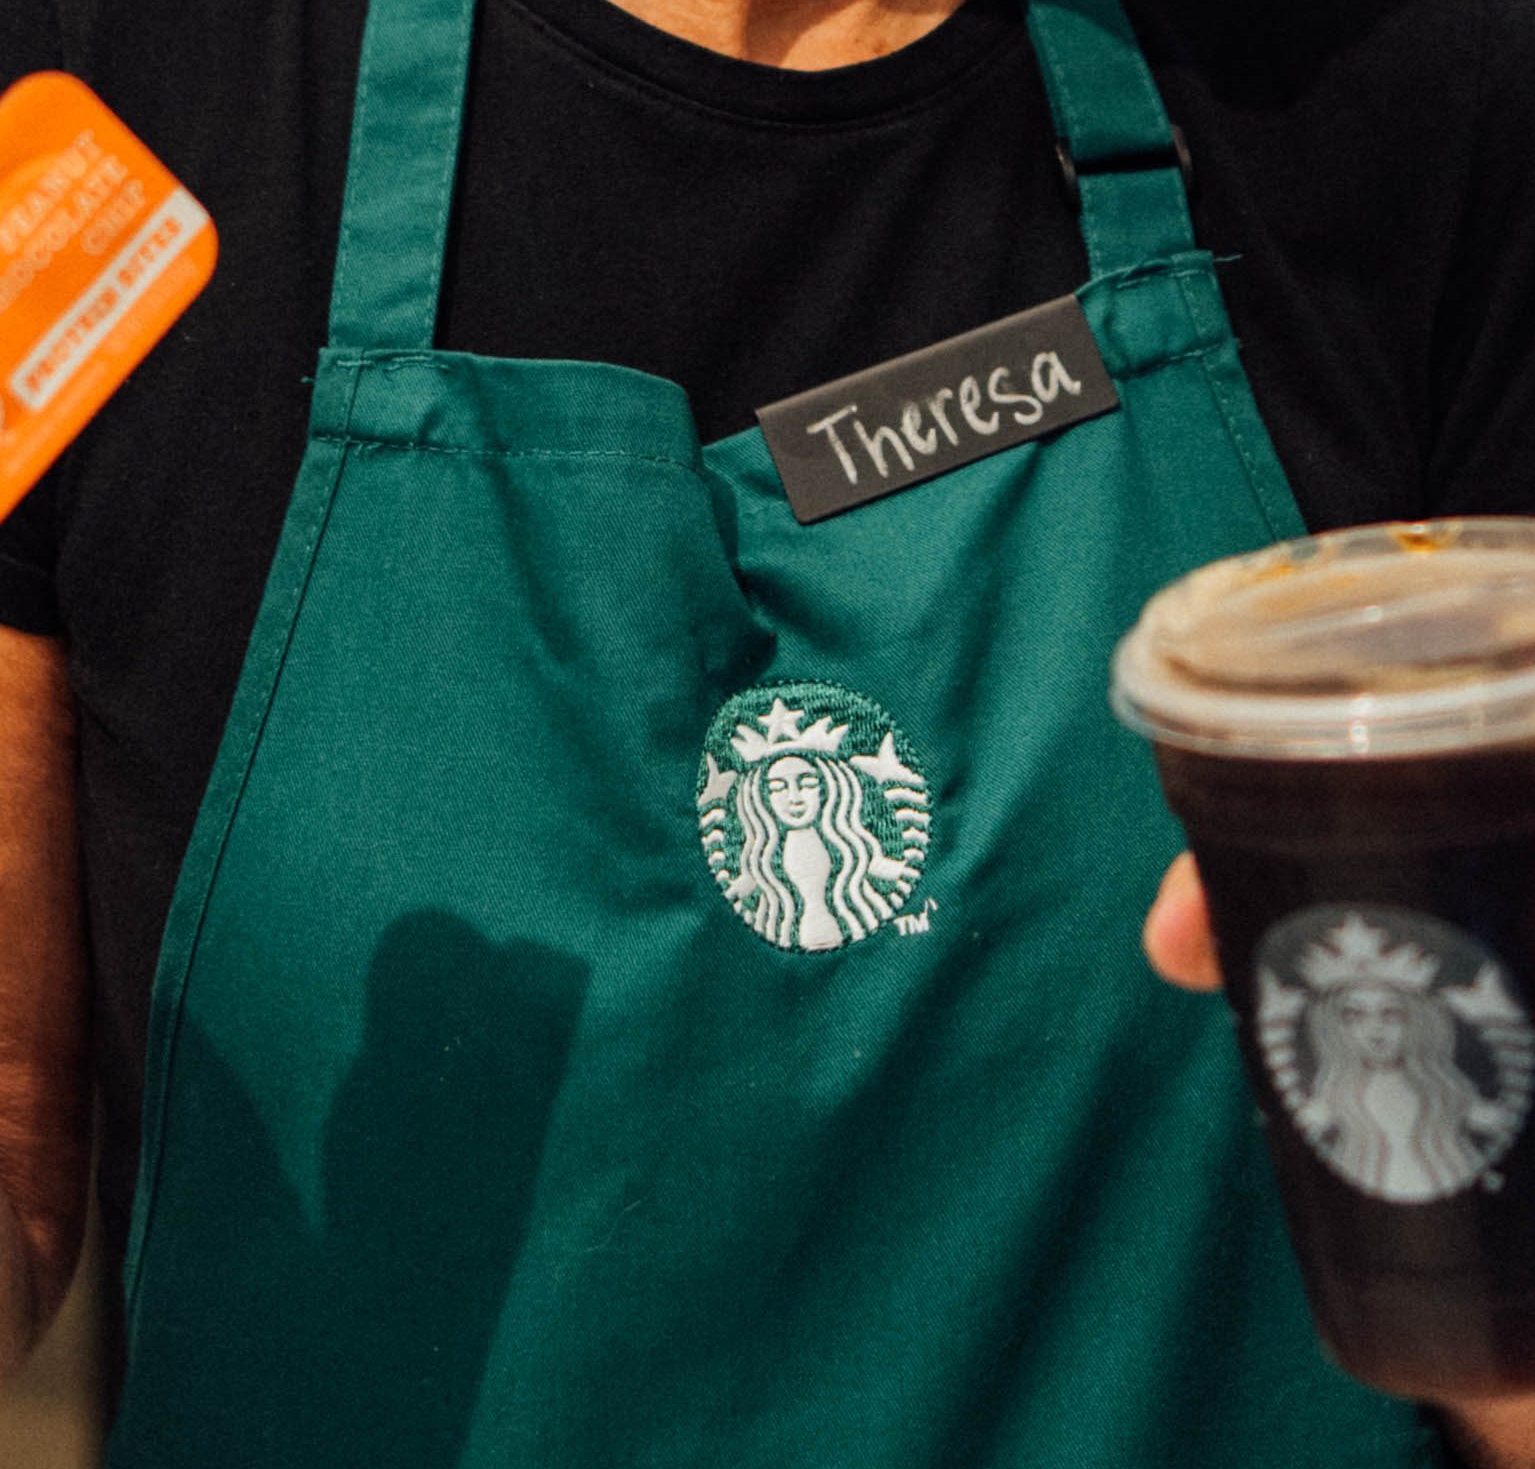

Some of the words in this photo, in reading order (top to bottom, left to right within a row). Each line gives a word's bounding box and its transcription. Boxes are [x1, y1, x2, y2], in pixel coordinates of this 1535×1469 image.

[81, 179, 148, 255] CHIP
[116, 215, 183, 290] BITES
[806, 348, 1082, 486] Theresa
